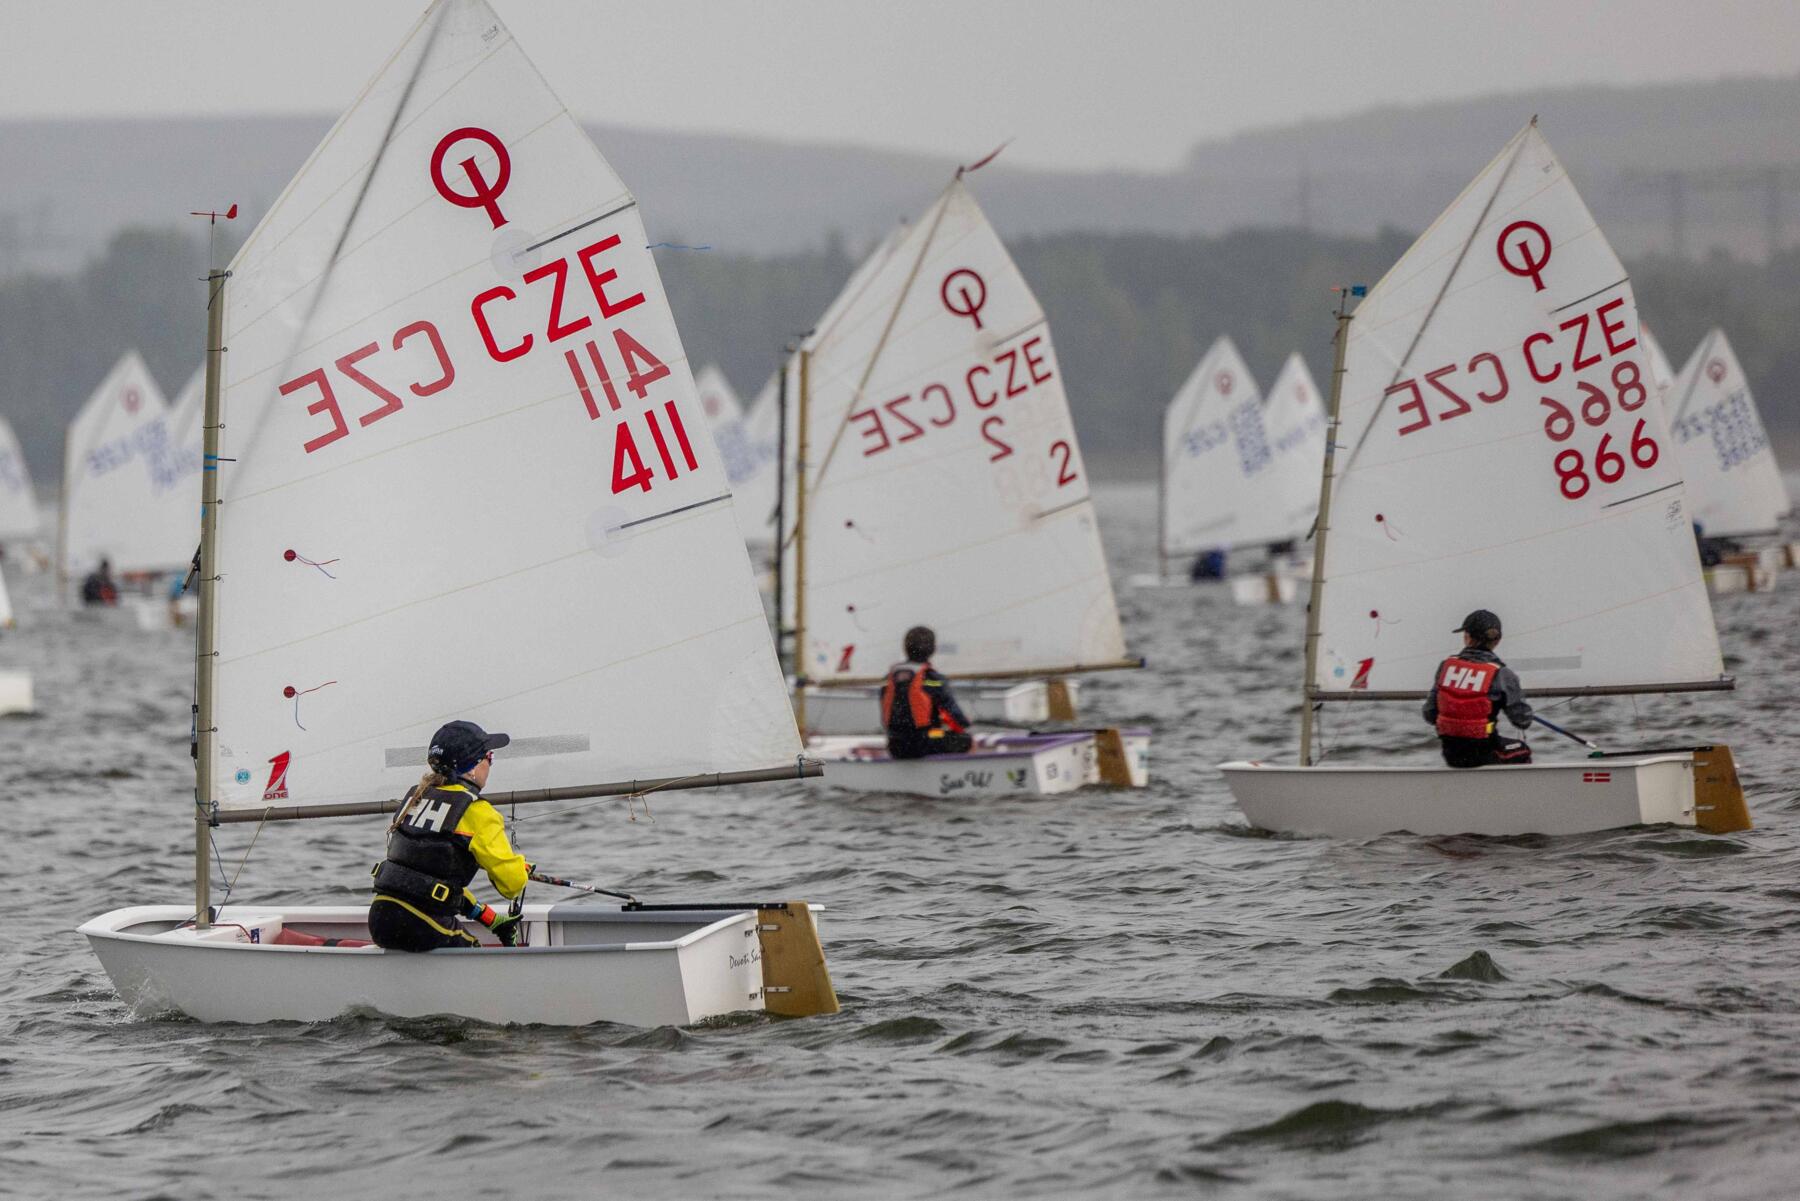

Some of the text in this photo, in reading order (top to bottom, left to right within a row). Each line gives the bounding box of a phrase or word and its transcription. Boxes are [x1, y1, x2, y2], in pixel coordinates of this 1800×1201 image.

[470, 233, 647, 363] CZE
[963, 335, 1053, 411] CZE
[1521, 297, 1638, 384] CZE
[610, 400, 700, 495] 411
[1049, 439, 1079, 488] 2
[1553, 418, 1661, 501] 866
[1442, 665, 1487, 692] HH
[397, 796, 452, 833] HH
